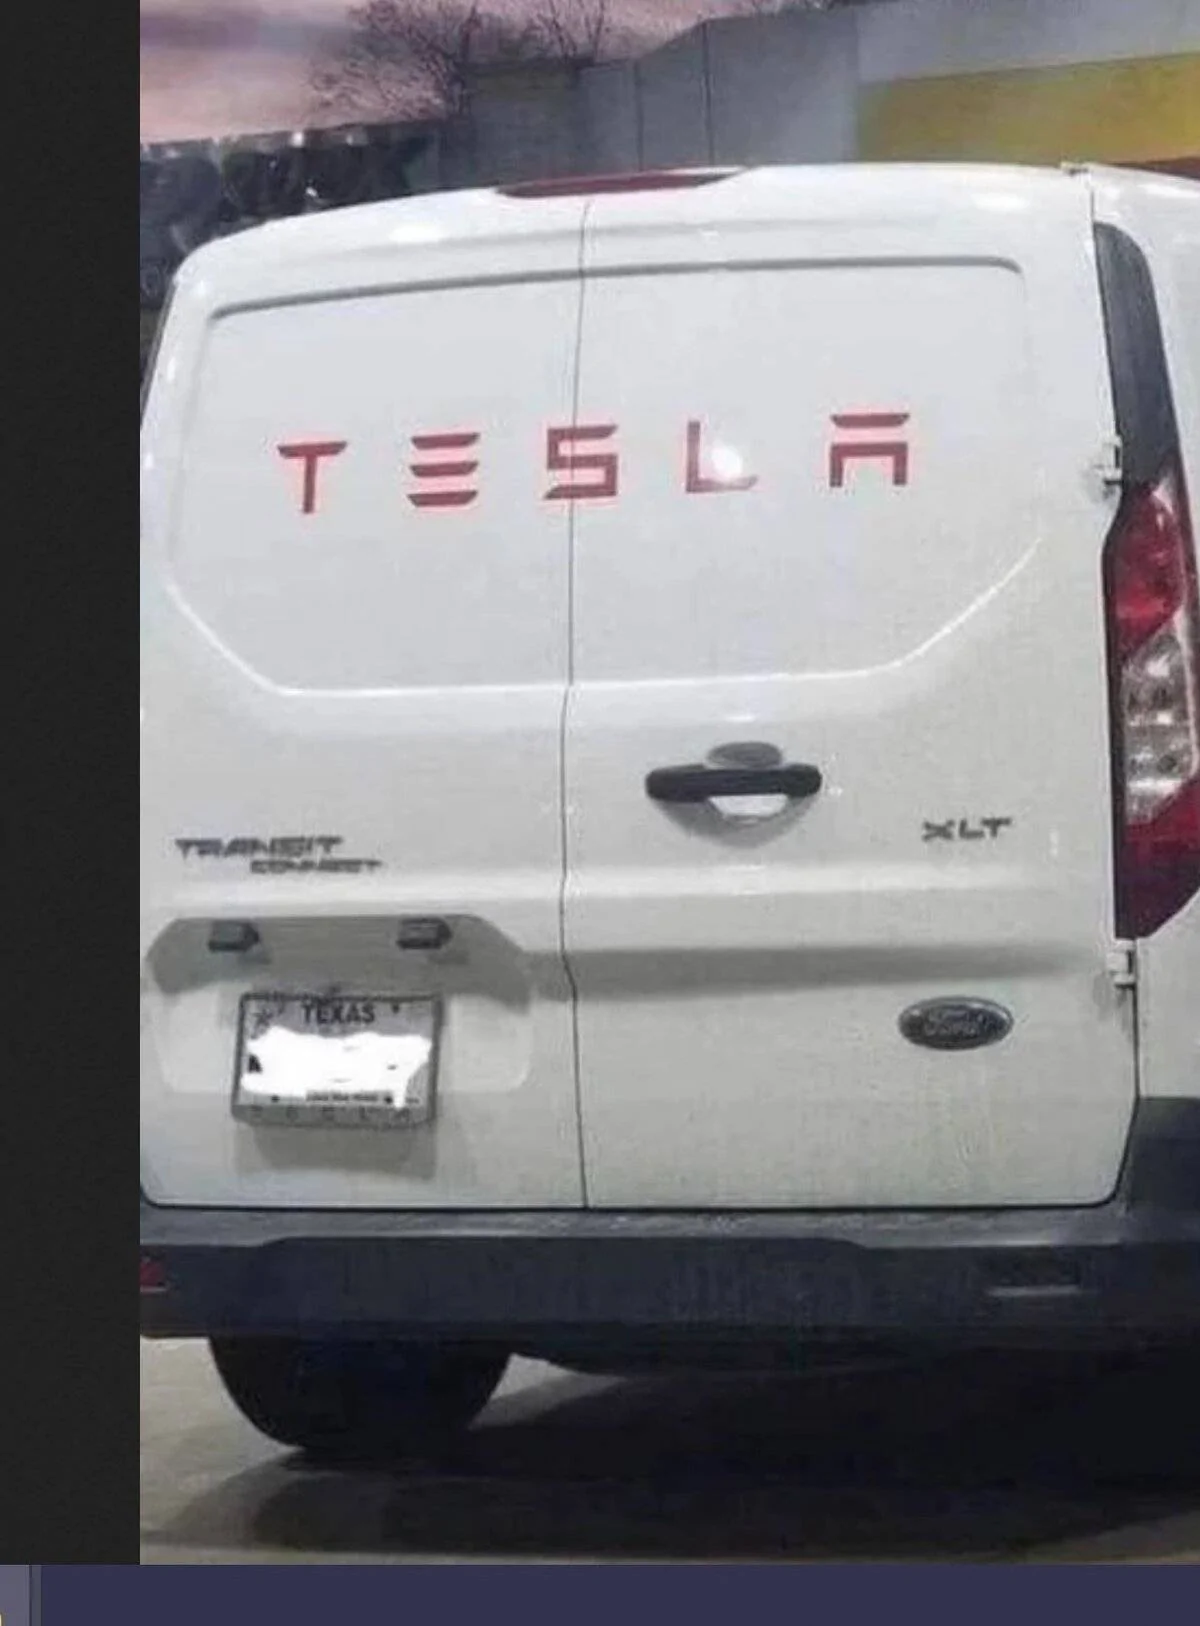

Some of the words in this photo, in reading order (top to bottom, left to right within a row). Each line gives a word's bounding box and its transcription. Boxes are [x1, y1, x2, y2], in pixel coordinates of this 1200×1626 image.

[277, 412, 910, 514] TESLA
[922, 816, 1012, 842] XLT
[302, 1003, 376, 1025] TEXAS
